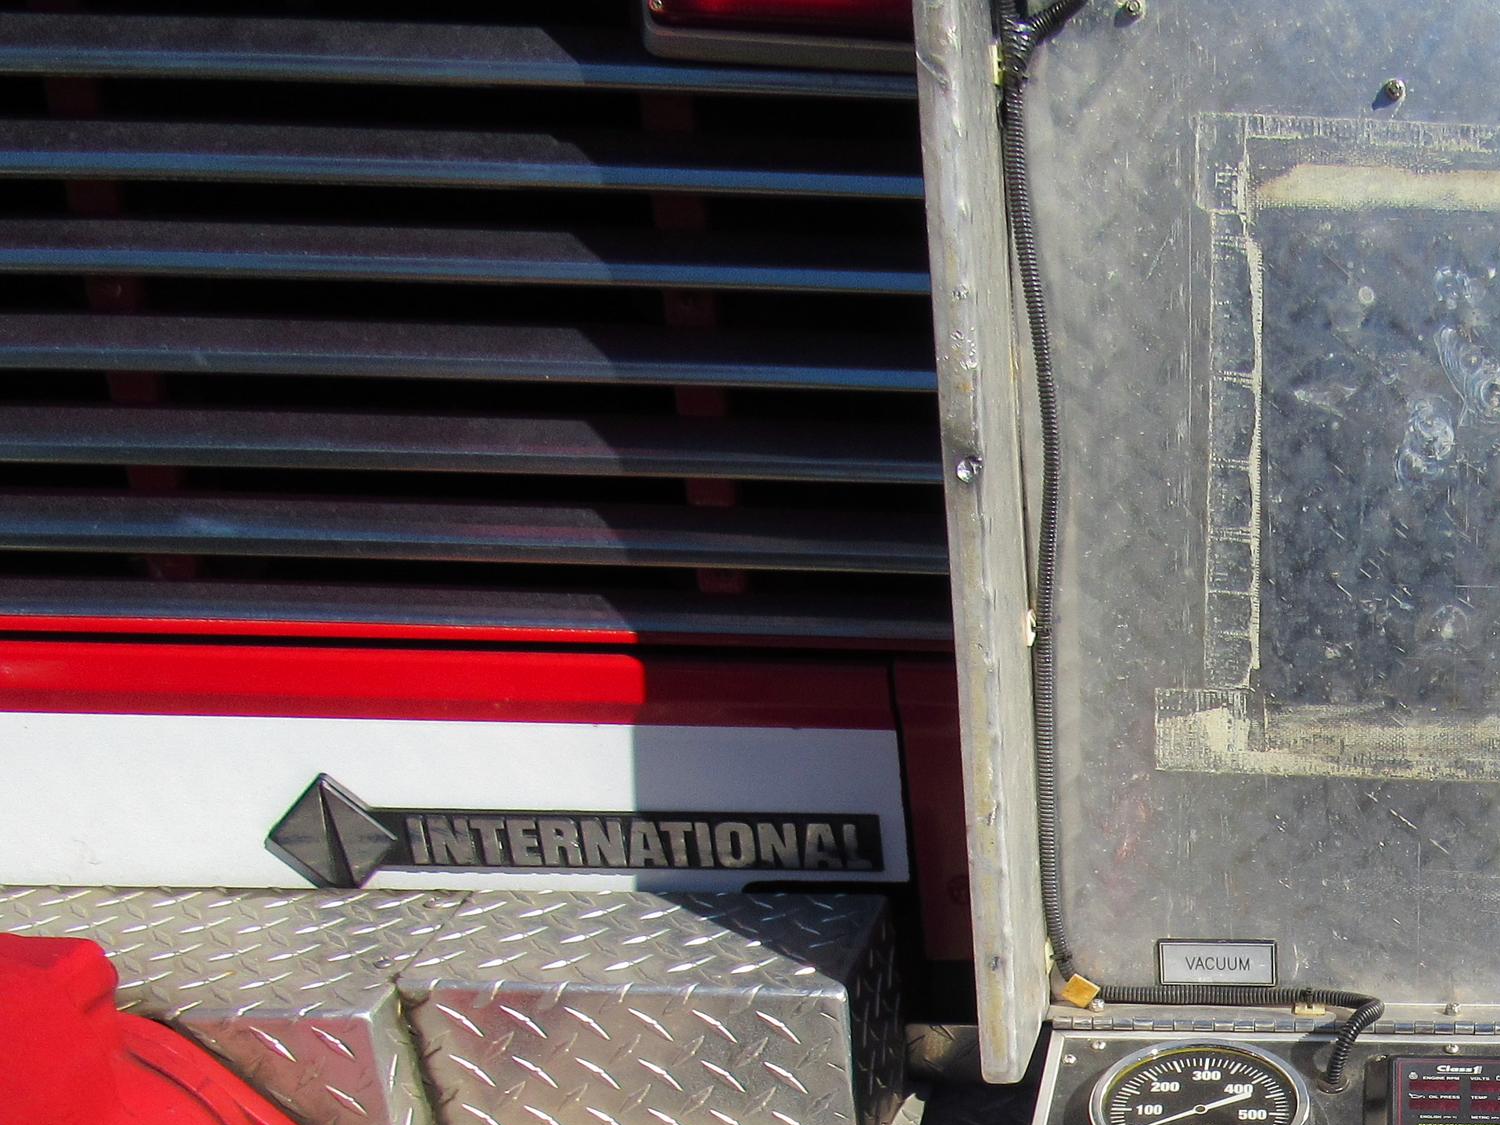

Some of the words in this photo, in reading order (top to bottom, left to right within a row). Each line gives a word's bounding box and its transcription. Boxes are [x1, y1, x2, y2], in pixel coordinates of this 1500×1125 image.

[406, 814, 873, 870] INTERNATIONAL
[1185, 956, 1251, 971] VACUUM
[1191, 1070, 1222, 1081] 300
[1150, 1081, 1180, 1093] 200
[1223, 1083, 1254, 1095] 400
[1136, 1104, 1163, 1115] 100
[1238, 1109, 1268, 1121] 500
